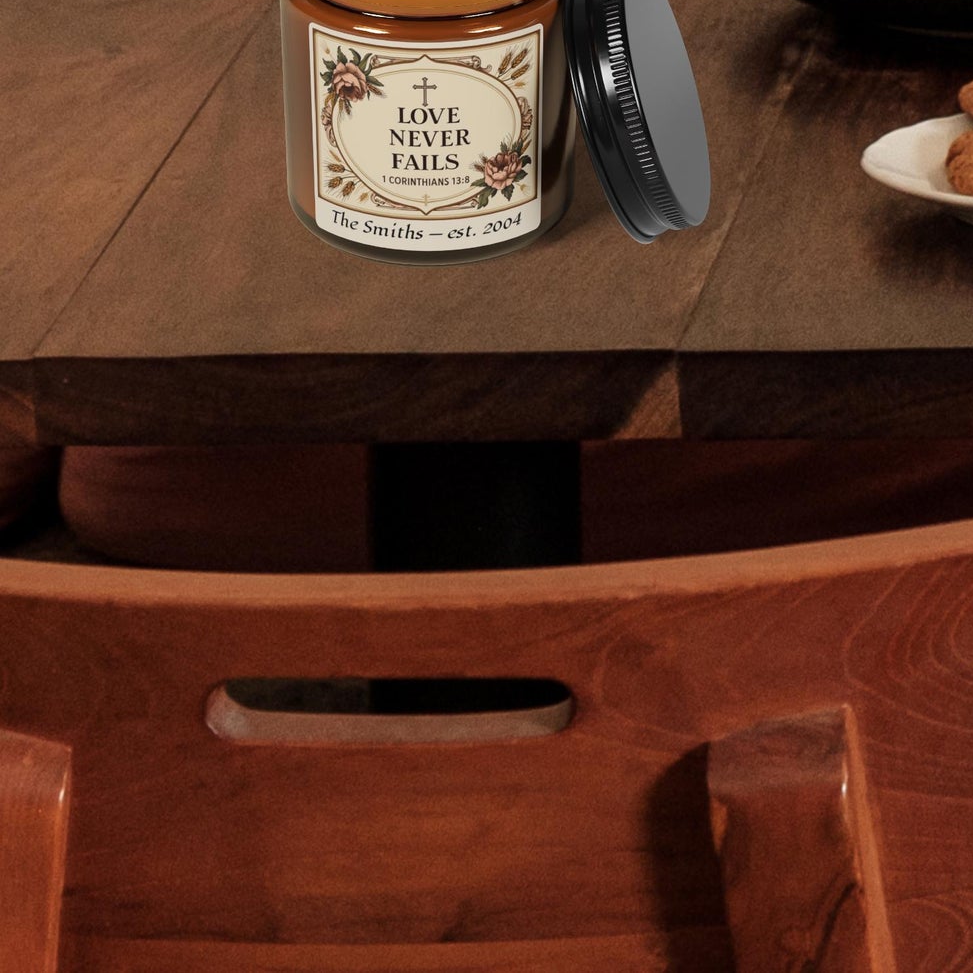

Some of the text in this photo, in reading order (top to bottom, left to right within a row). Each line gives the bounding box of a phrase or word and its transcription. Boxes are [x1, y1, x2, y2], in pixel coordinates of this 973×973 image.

[397, 107, 460, 124] LOVE
[389, 129, 471, 147] NEVER
[392, 153, 459, 171] FAILS
[389, 176, 449, 186] CORINTHIANS
[452, 176, 470, 185] 13:8
[331, 210, 358, 230] The
[363, 220, 423, 240] Smiths
[447, 226, 477, 239] est.
[482, 211, 522, 235] 2004
